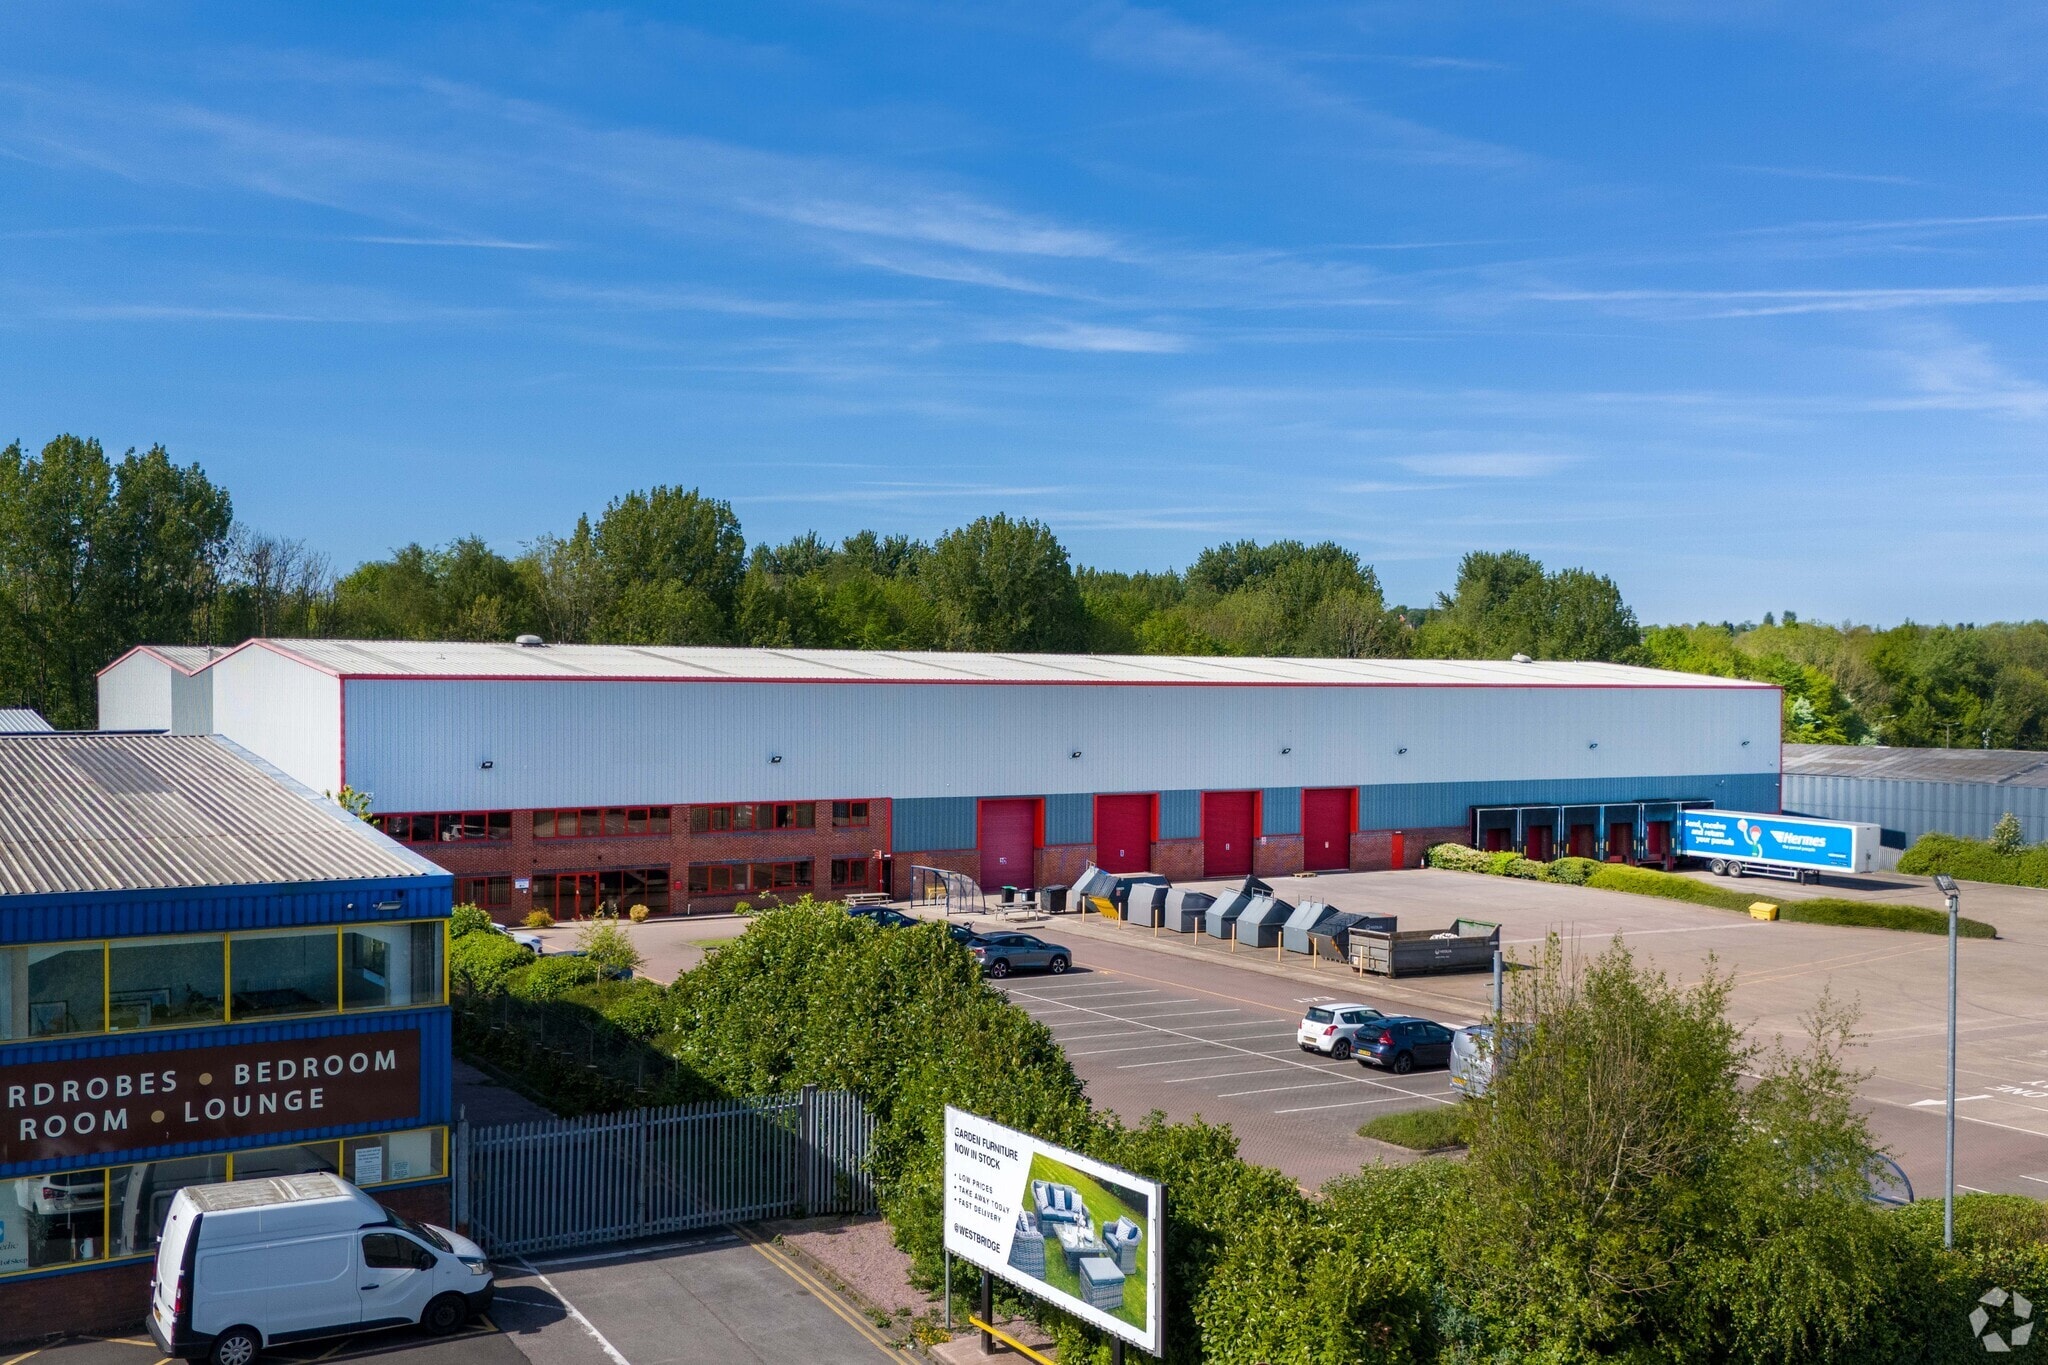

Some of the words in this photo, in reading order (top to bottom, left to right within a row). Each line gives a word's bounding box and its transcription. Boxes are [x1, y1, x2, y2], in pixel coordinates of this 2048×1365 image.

[1783, 832, 1826, 847] Hermes
[8, 1070, 177, 1108] RDROBES
[234, 1049, 396, 1085] BEDROOM
[20, 1108, 128, 1141] ROOM
[184, 1087, 324, 1123] LOUNGE
[954, 1127, 981, 1146] GARDEN
[982, 1138, 1019, 1162] FURNITURE
[954, 1142, 970, 1157] NOW
[971, 1148, 977, 1160] IN
[978, 1152, 1001, 1170] STOCK
[959, 1173, 971, 1184] LOW
[972, 1179, 993, 1194] PRICES
[959, 1185, 973, 1198] TAKE
[974, 1193, 990, 1206] AWAY
[991, 1200, 1010, 1215] TODAY
[959, 1198, 972, 1210] FAST
[974, 1205, 1002, 1223] DELIVERY
[954, 1222, 1001, 1254] @WESTBRIDGE
